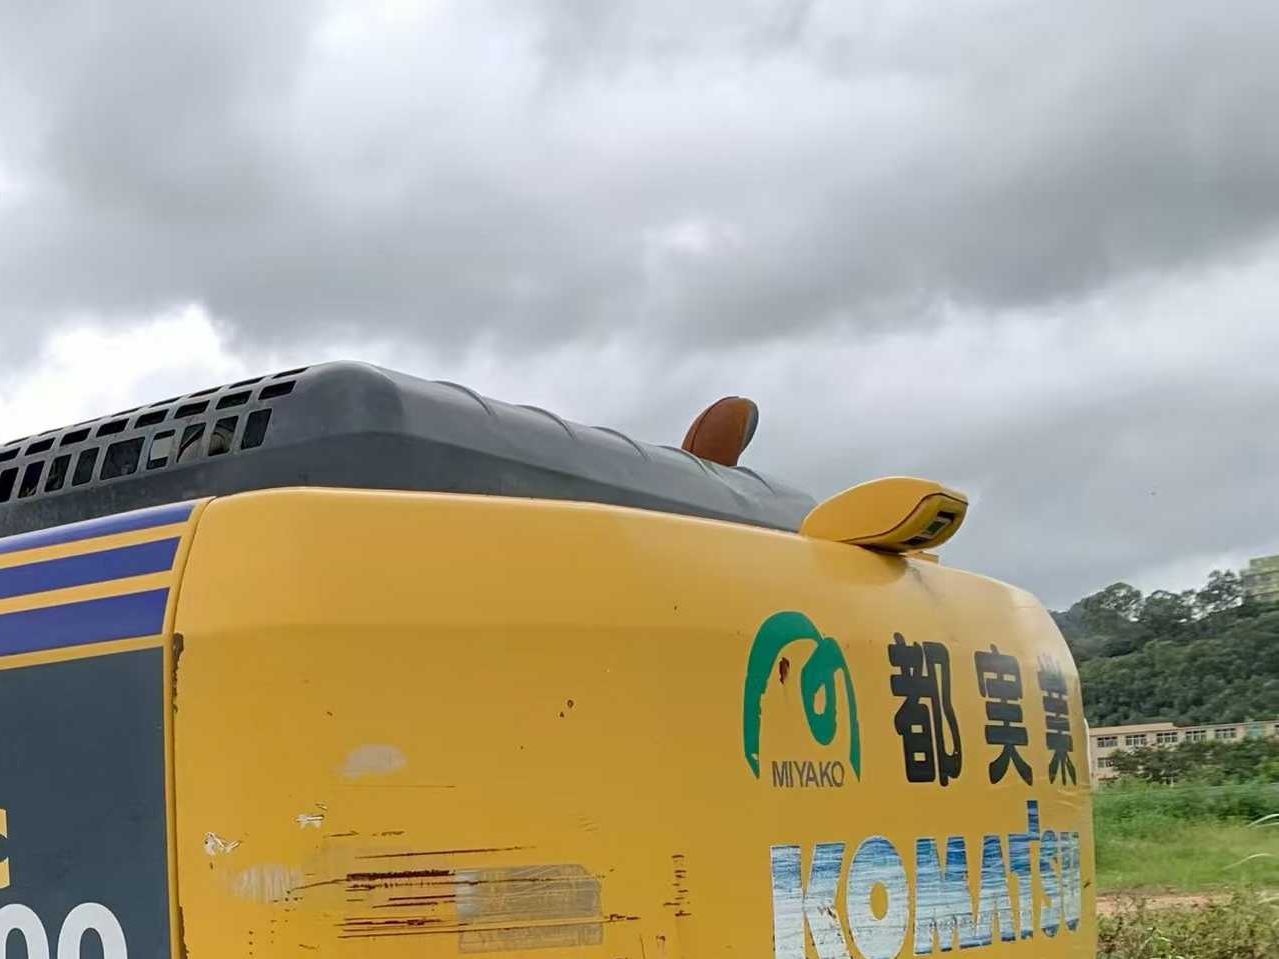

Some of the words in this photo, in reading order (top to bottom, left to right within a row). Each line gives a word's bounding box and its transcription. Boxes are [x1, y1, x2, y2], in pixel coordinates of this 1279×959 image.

[888, 632, 1077, 787] 都実業
[771, 760, 845, 788] MIYAKO
